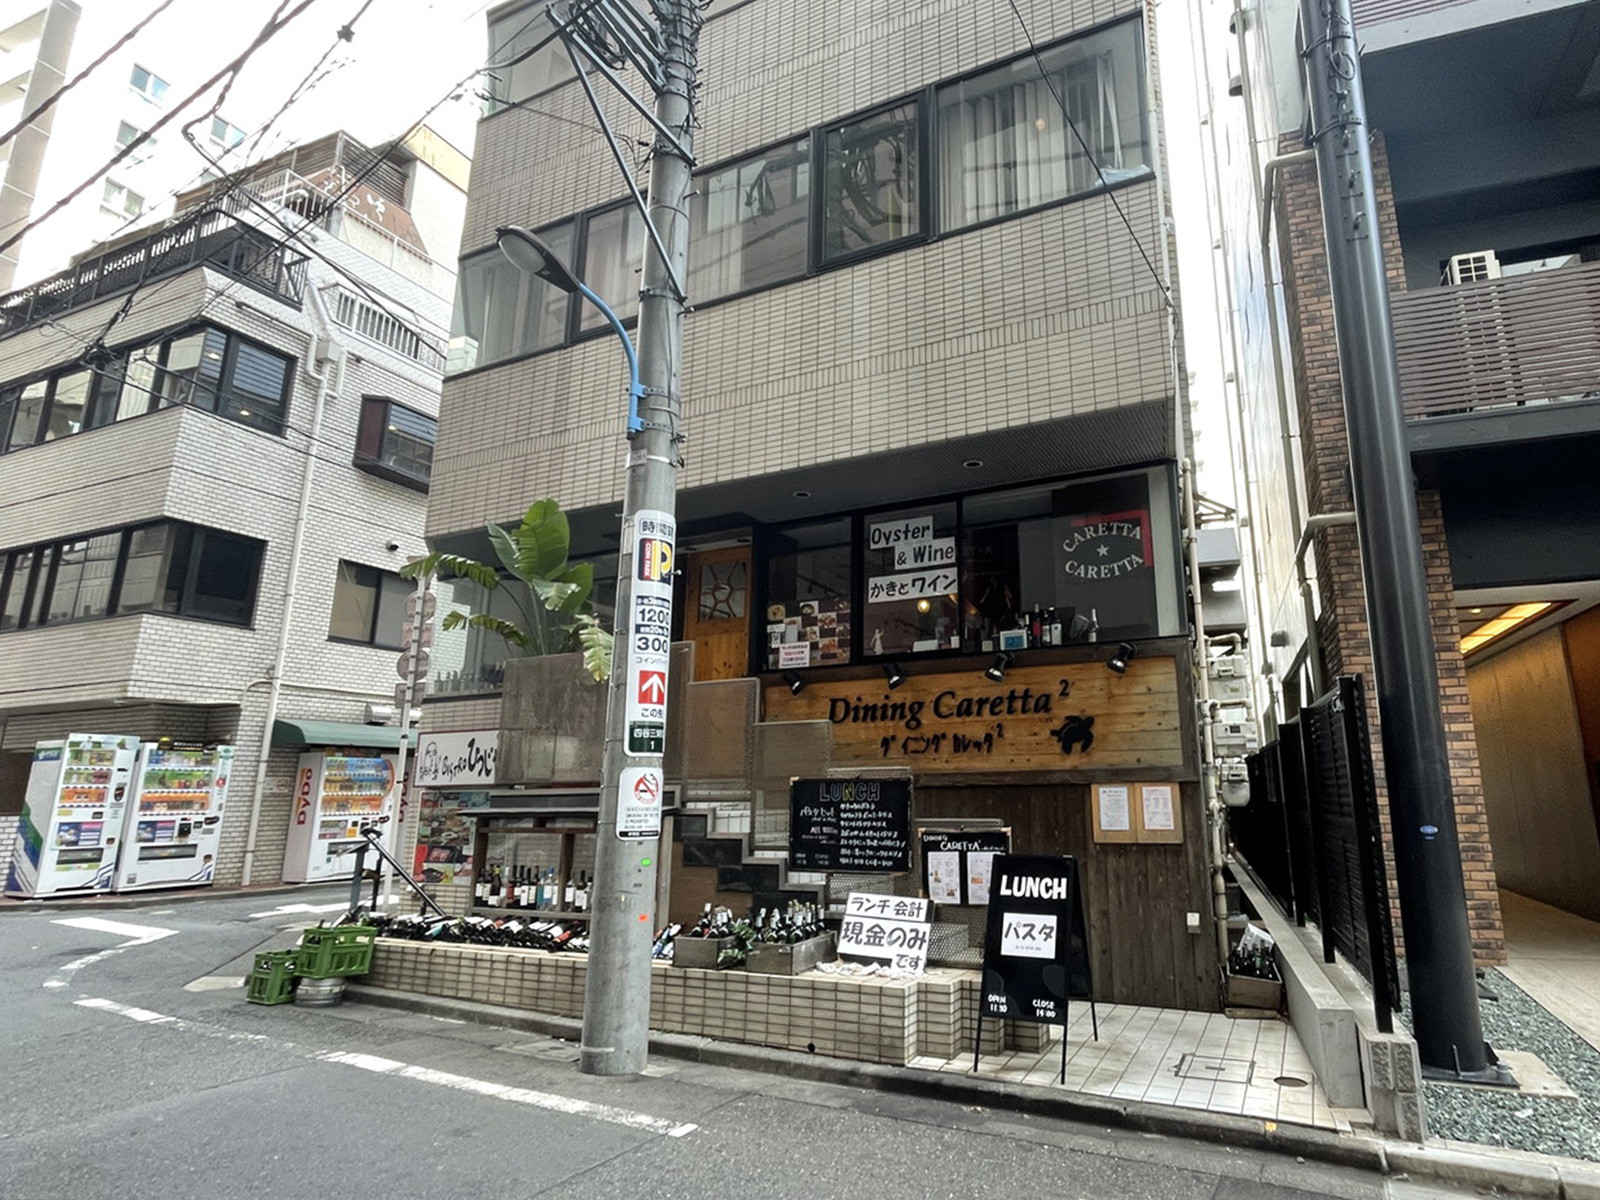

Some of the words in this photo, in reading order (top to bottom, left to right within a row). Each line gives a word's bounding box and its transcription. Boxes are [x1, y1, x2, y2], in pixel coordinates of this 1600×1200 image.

[871, 523, 931, 545] Oyster
[1063, 522, 1141, 553] CARETTA
[896, 551, 907, 565] &
[913, 545, 954, 563] Wine
[1064, 553, 1144, 579] CARETTA
[870, 574, 957, 599] かきとワイン
[829, 694, 925, 731] Dining
[932, 688, 1052, 719] Caretta
[650, 741, 655, 750] 1
[820, 783, 881, 802] LUNCH
[1000, 875, 1068, 900] LUNCH
[851, 897, 890, 914] ランチ
[893, 900, 923, 918] 会計
[842, 921, 927, 950] 現金のみ
[1004, 921, 1055, 942] パスタ
[896, 954, 922, 970] です
[1032, 999, 1055, 1009] CLOSE
